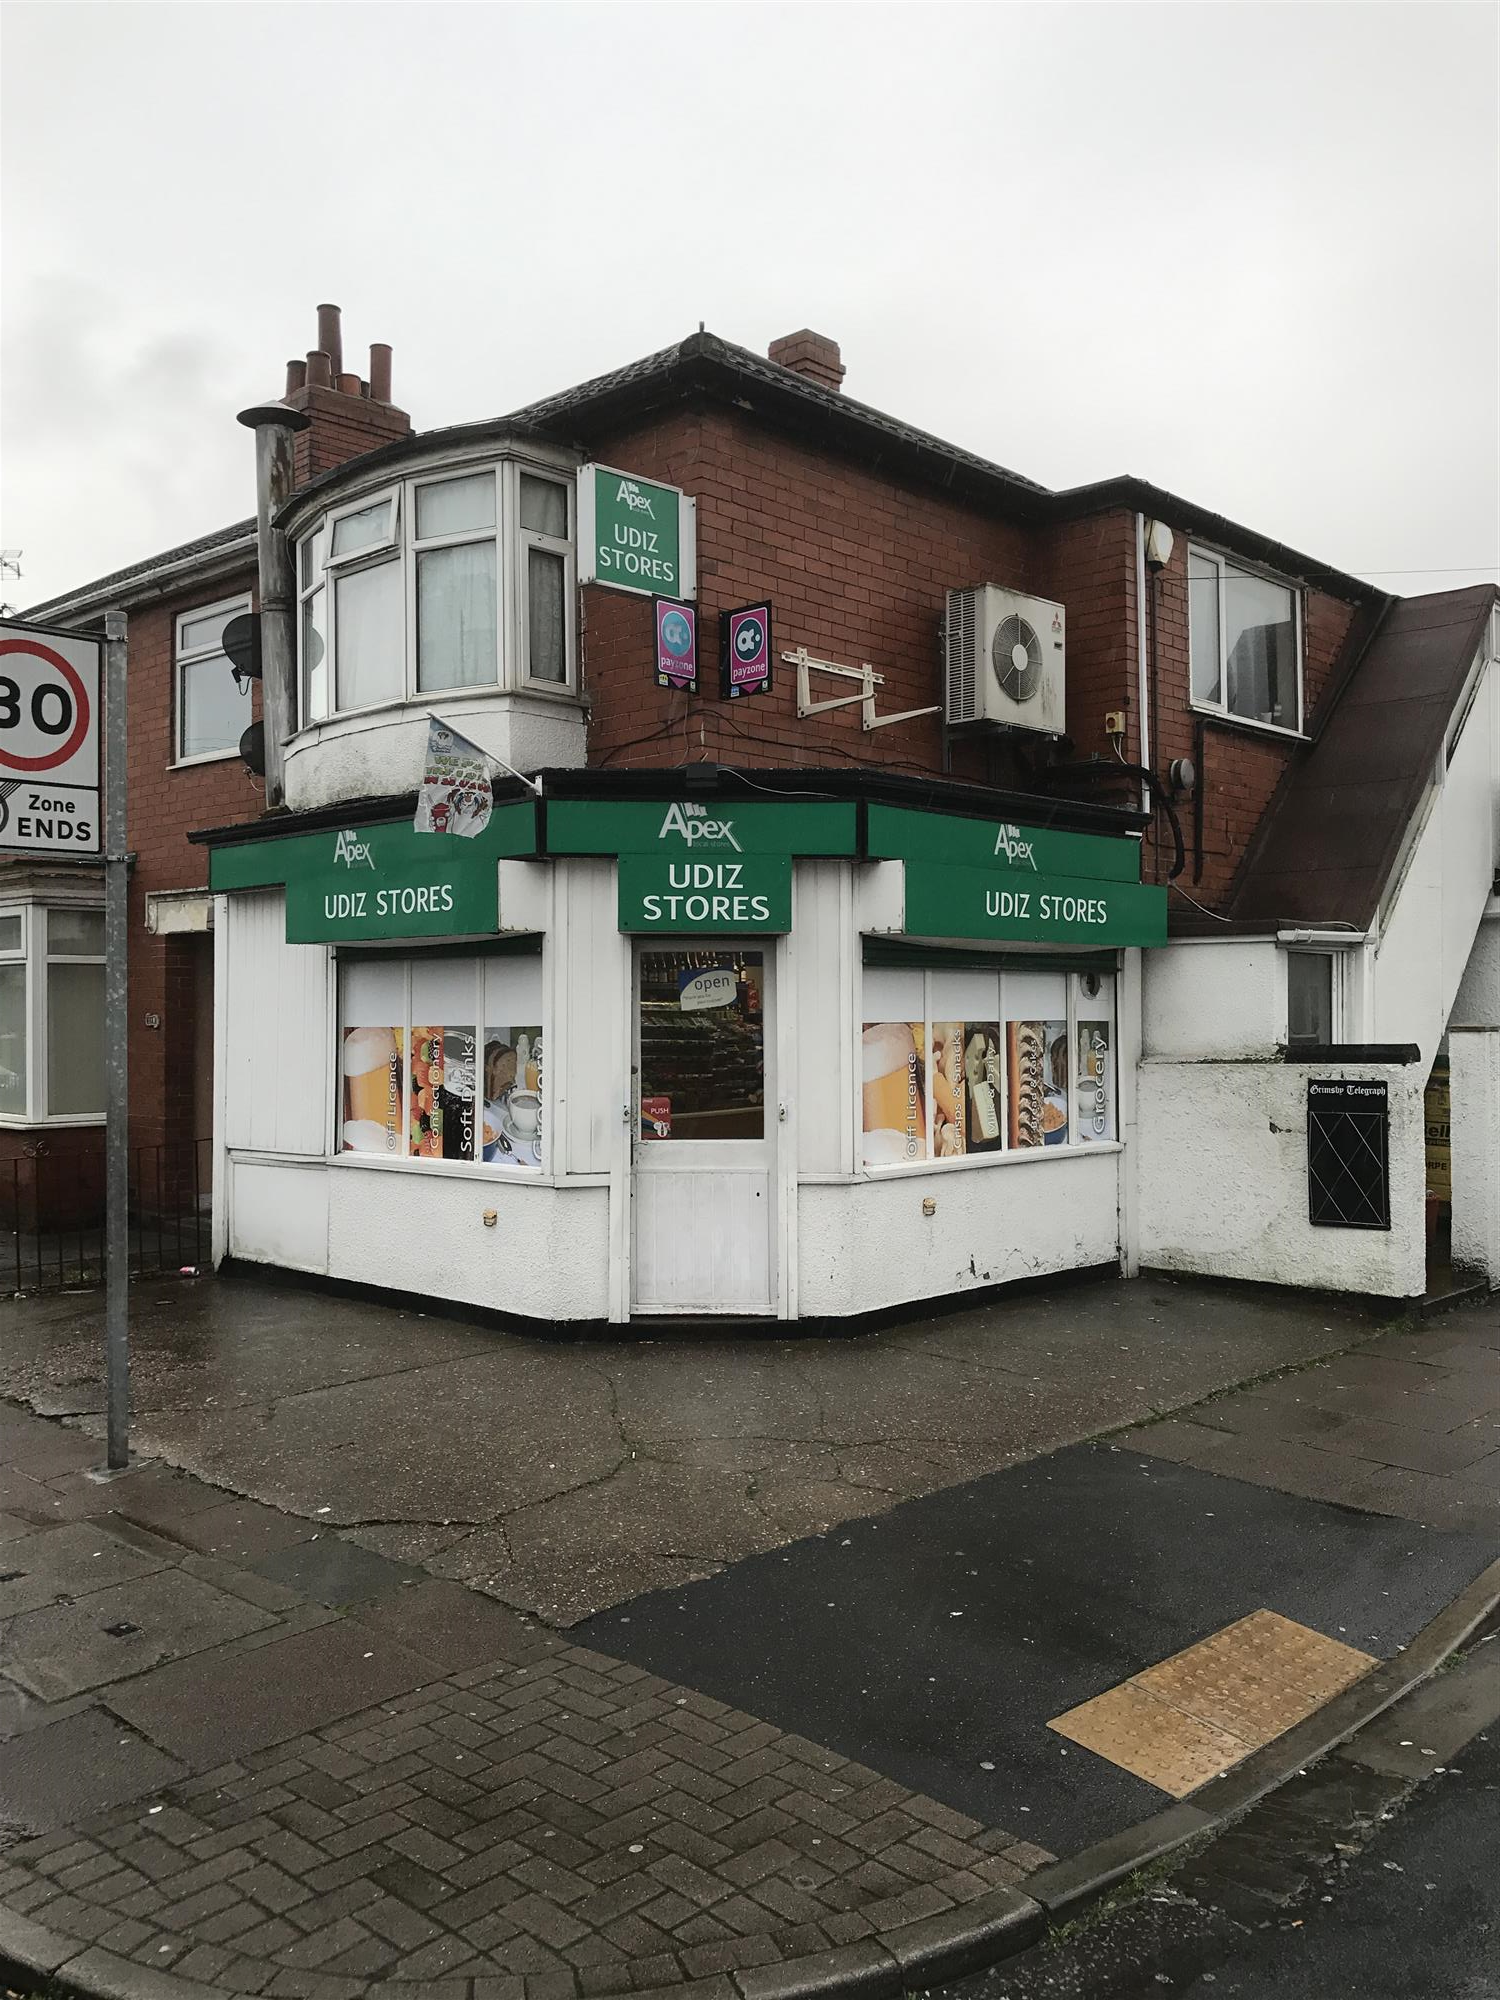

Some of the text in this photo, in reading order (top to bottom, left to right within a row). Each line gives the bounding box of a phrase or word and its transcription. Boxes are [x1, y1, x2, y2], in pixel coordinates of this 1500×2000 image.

[616, 480, 656, 520] Apex
[614, 523, 659, 554] UDIZ
[599, 546, 675, 583] STORES
[661, 655, 693, 672] payzone
[733, 662, 765, 680] payzone
[0, 676, 73, 735] 30
[28, 794, 76, 813] Zone
[18, 817, 91, 841] ENDS
[658, 801, 743, 853] Apex
[333, 829, 376, 870] Apex
[994, 824, 1038, 871] Apex
[668, 863, 744, 890] UDIZ
[324, 884, 454, 919] UDIZ STORES
[642, 895, 770, 921] STORES
[985, 890, 1107, 924] UDIZ STORES
[694, 977, 730, 992] open
[386, 1052, 397, 1150] Off Licence
[431, 1033, 443, 1148] Confectionery
[460, 1035, 476, 1152] Soft Drinks
[953, 1030, 964, 1149] Crisps & Snacks
[987, 1046, 997, 1136] Milk & Dairy
[1029, 1039, 1038, 1128] Bread & Cakes
[1092, 1036, 1107, 1134] Grocery
[1309, 1084, 1386, 1096] Grimsby Telegraph
[906, 1052, 917, 1155] Off Licence
[1426, 1161, 1447, 1171] RPE
